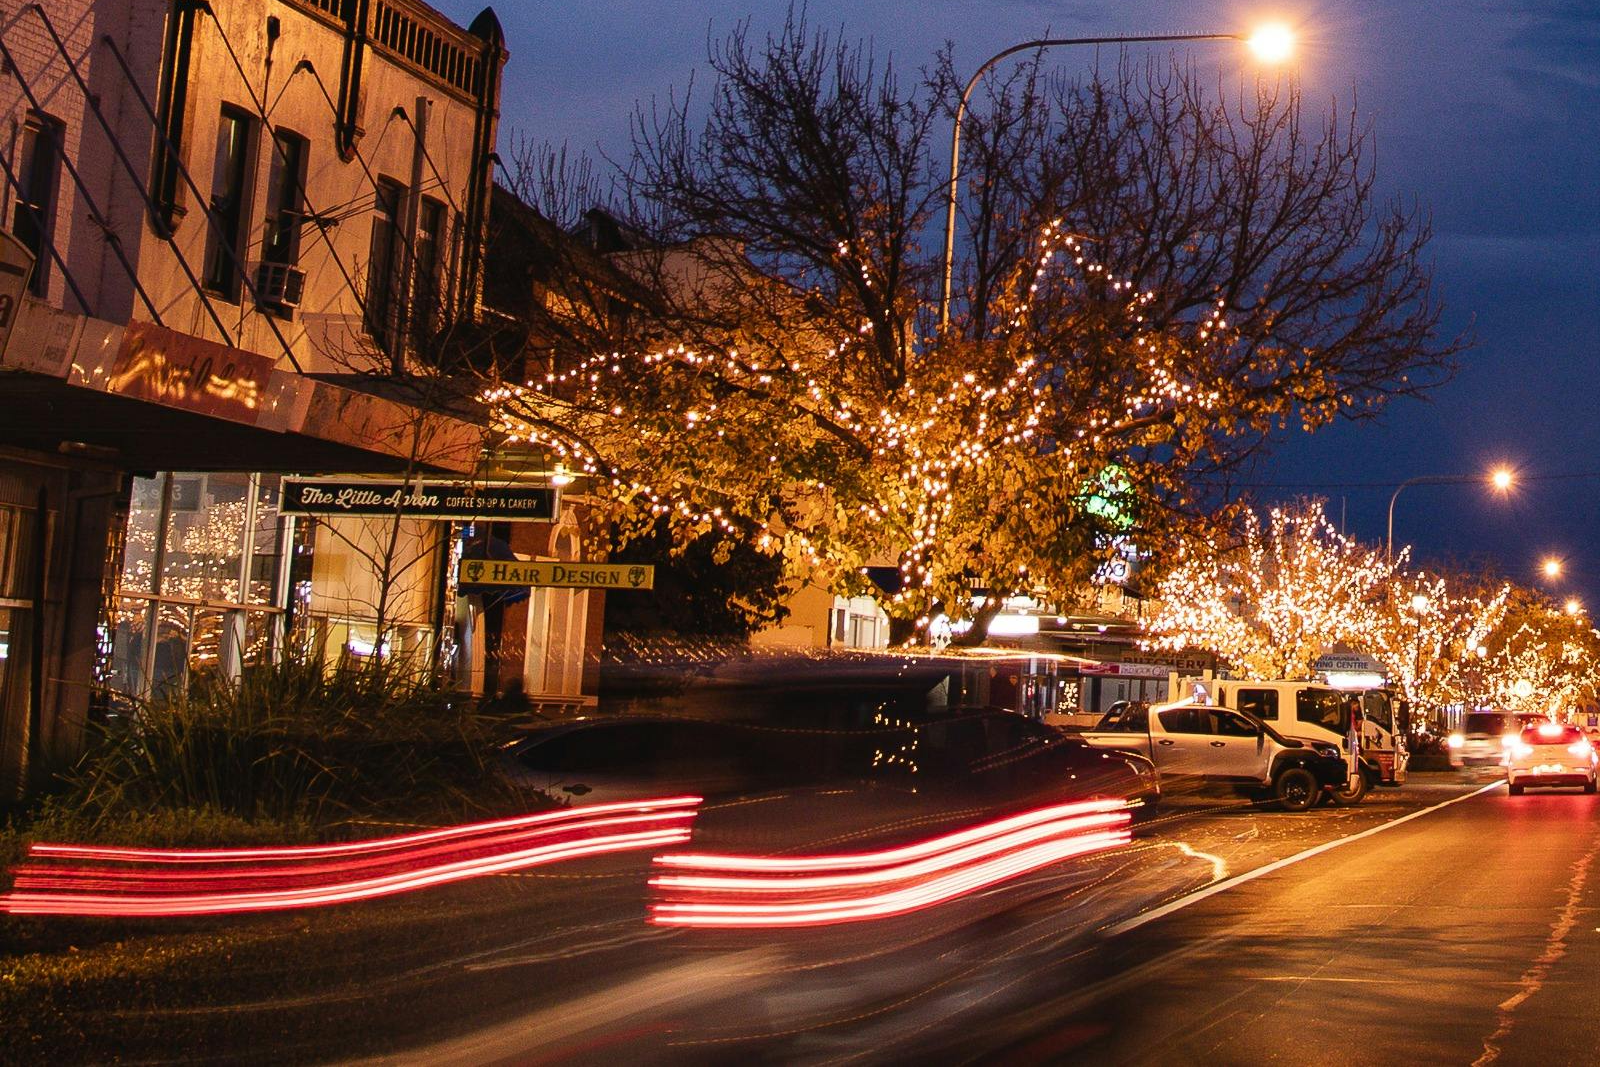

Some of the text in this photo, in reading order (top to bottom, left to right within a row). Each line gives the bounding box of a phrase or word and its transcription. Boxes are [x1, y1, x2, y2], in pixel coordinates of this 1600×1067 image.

[301, 487, 333, 505] The
[335, 488, 382, 509] Little
[446, 496, 474, 509] COFFEE
[508, 498, 538, 510] CAKERY
[491, 564, 621, 584] HAIR DESIGN
[1122, 656, 1207, 669] BUTCHERY
[1336, 661, 1369, 670] CENTRE
